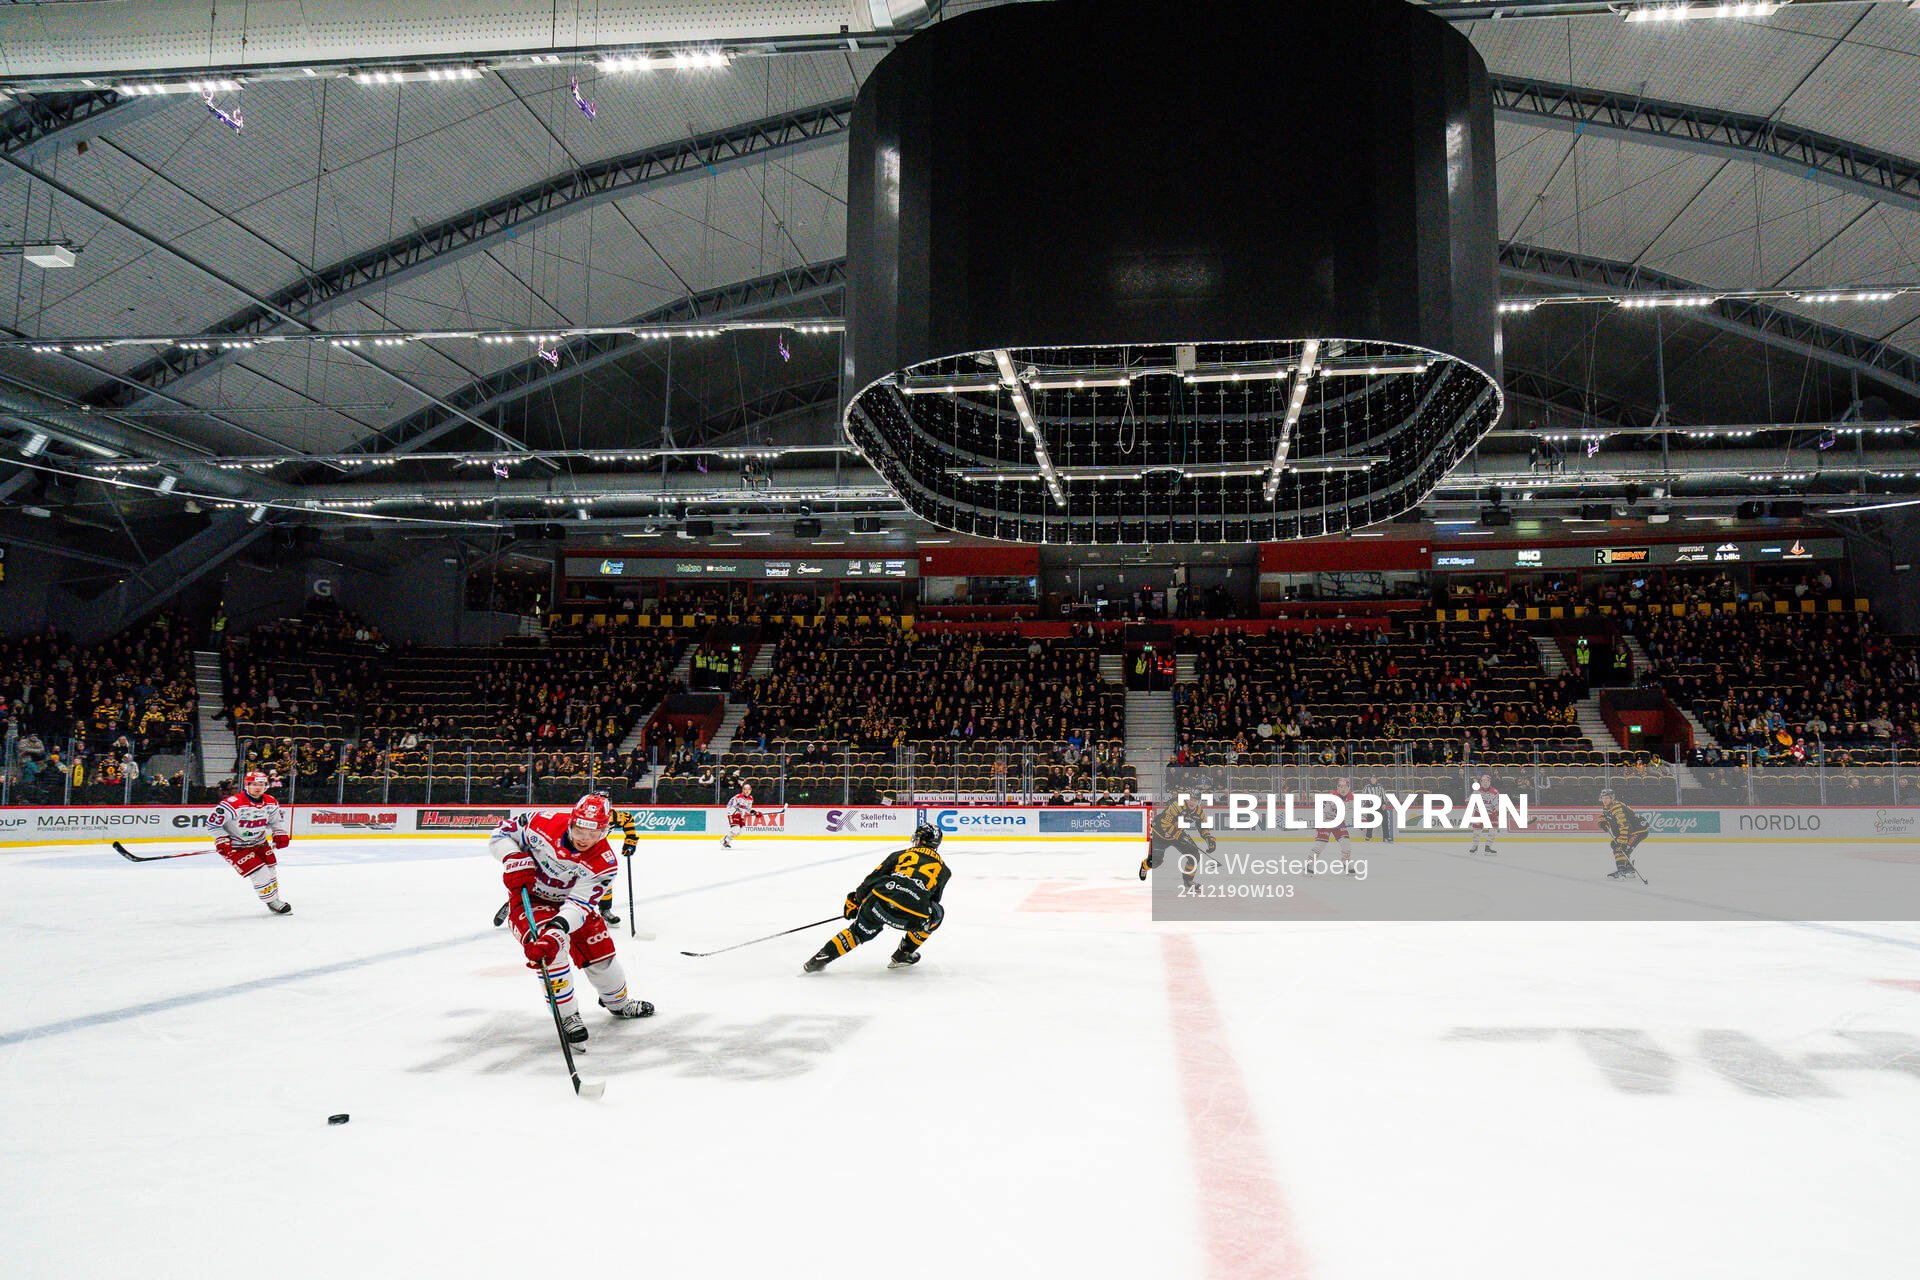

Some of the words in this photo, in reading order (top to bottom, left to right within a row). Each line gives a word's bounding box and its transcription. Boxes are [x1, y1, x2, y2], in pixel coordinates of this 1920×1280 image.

[313, 579, 331, 596] G
[37, 814, 160, 826] MARTINSONS
[208, 813, 225, 826] 63
[860, 813, 896, 821] Skellefteå
[894, 851, 943, 890] 24
